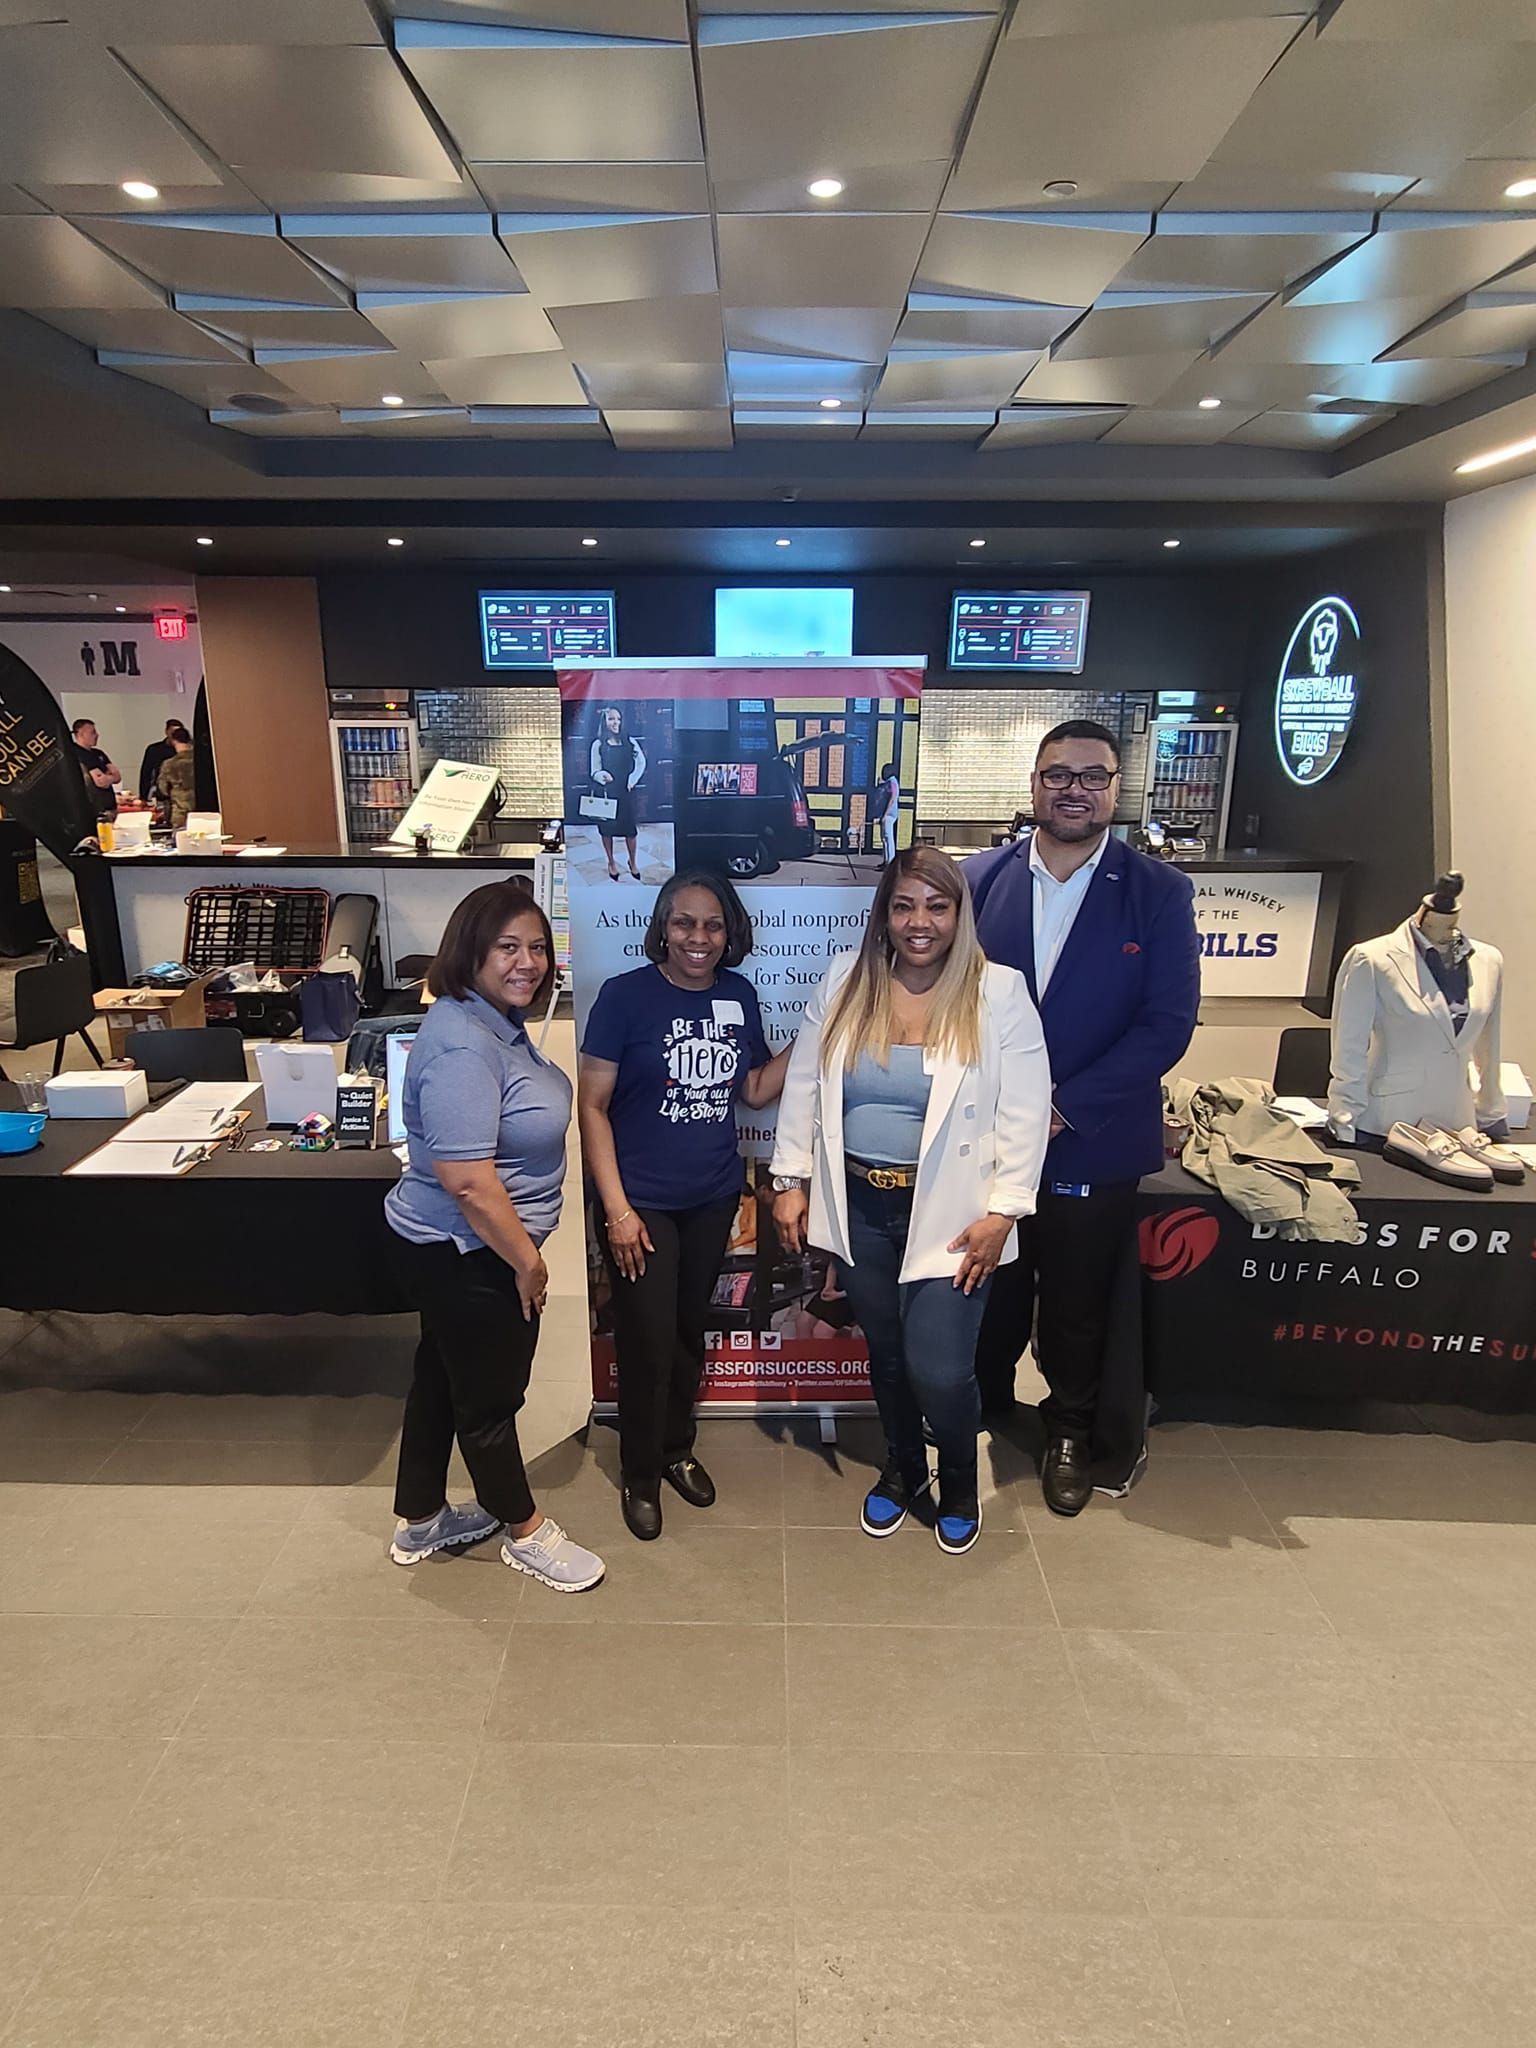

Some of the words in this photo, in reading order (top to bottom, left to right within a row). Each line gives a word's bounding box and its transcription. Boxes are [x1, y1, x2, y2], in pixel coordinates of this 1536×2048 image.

[159, 619, 184, 638] EXIT
[100, 641, 141, 676] M
[1291, 731, 1330, 755] BILLS
[0, 749, 33, 785] CAN
[461, 773, 490, 782] HERO
[1224, 887, 1286, 913] WHISKEY
[595, 909, 620, 928] As
[1213, 910, 1239, 920] THE
[754, 967, 780, 985] for
[672, 1018, 694, 1039] BE
[699, 1018, 728, 1040] THE
[677, 1044, 734, 1080] Hero
[666, 1087, 682, 1100] OF
[659, 1099, 689, 1123] Life
[689, 1101, 728, 1122] Story
[1418, 1226, 1511, 1253] FOR
[1241, 1259, 1420, 1288] BUFFALO
